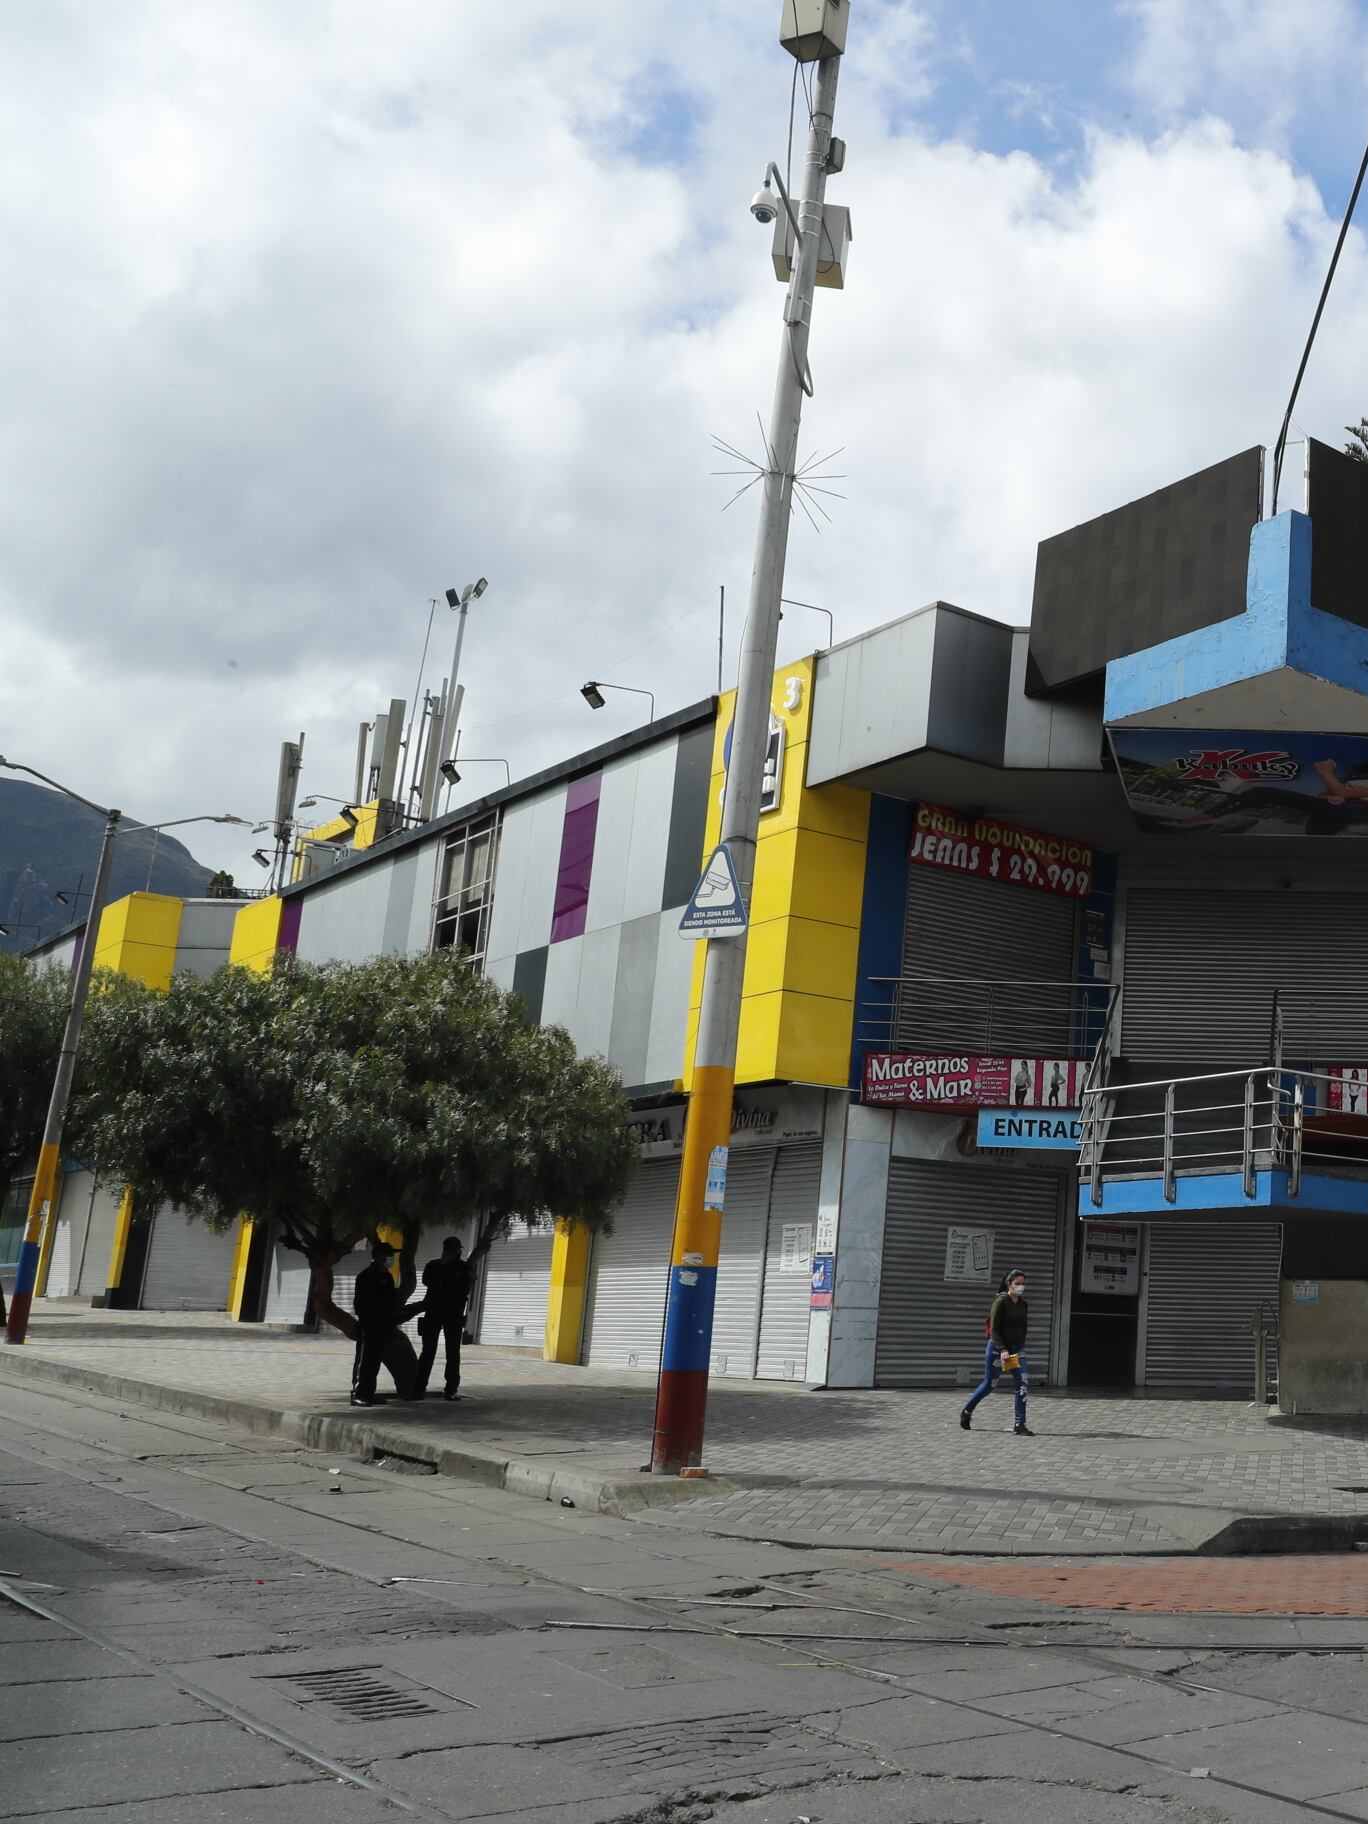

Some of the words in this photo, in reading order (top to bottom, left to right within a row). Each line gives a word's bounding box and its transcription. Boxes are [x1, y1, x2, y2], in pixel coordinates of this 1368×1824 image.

[783, 676, 804, 710] 3
[917, 809, 968, 837] GRAN
[911, 832, 980, 871] JEANS
[989, 847, 1002, 878] $
[1009, 854, 1090, 896] 29.999
[684, 919, 703, 927] SIENDO
[704, 917, 743, 926] MONITOREADA
[693, 911, 706, 919] ESTA
[707, 910, 721, 918] ZONA
[871, 1057, 969, 1081] Maternos
[909, 1080, 925, 1101] &
[927, 1076, 973, 1100] Mar
[994, 1118, 1092, 1140] ENTRAD
